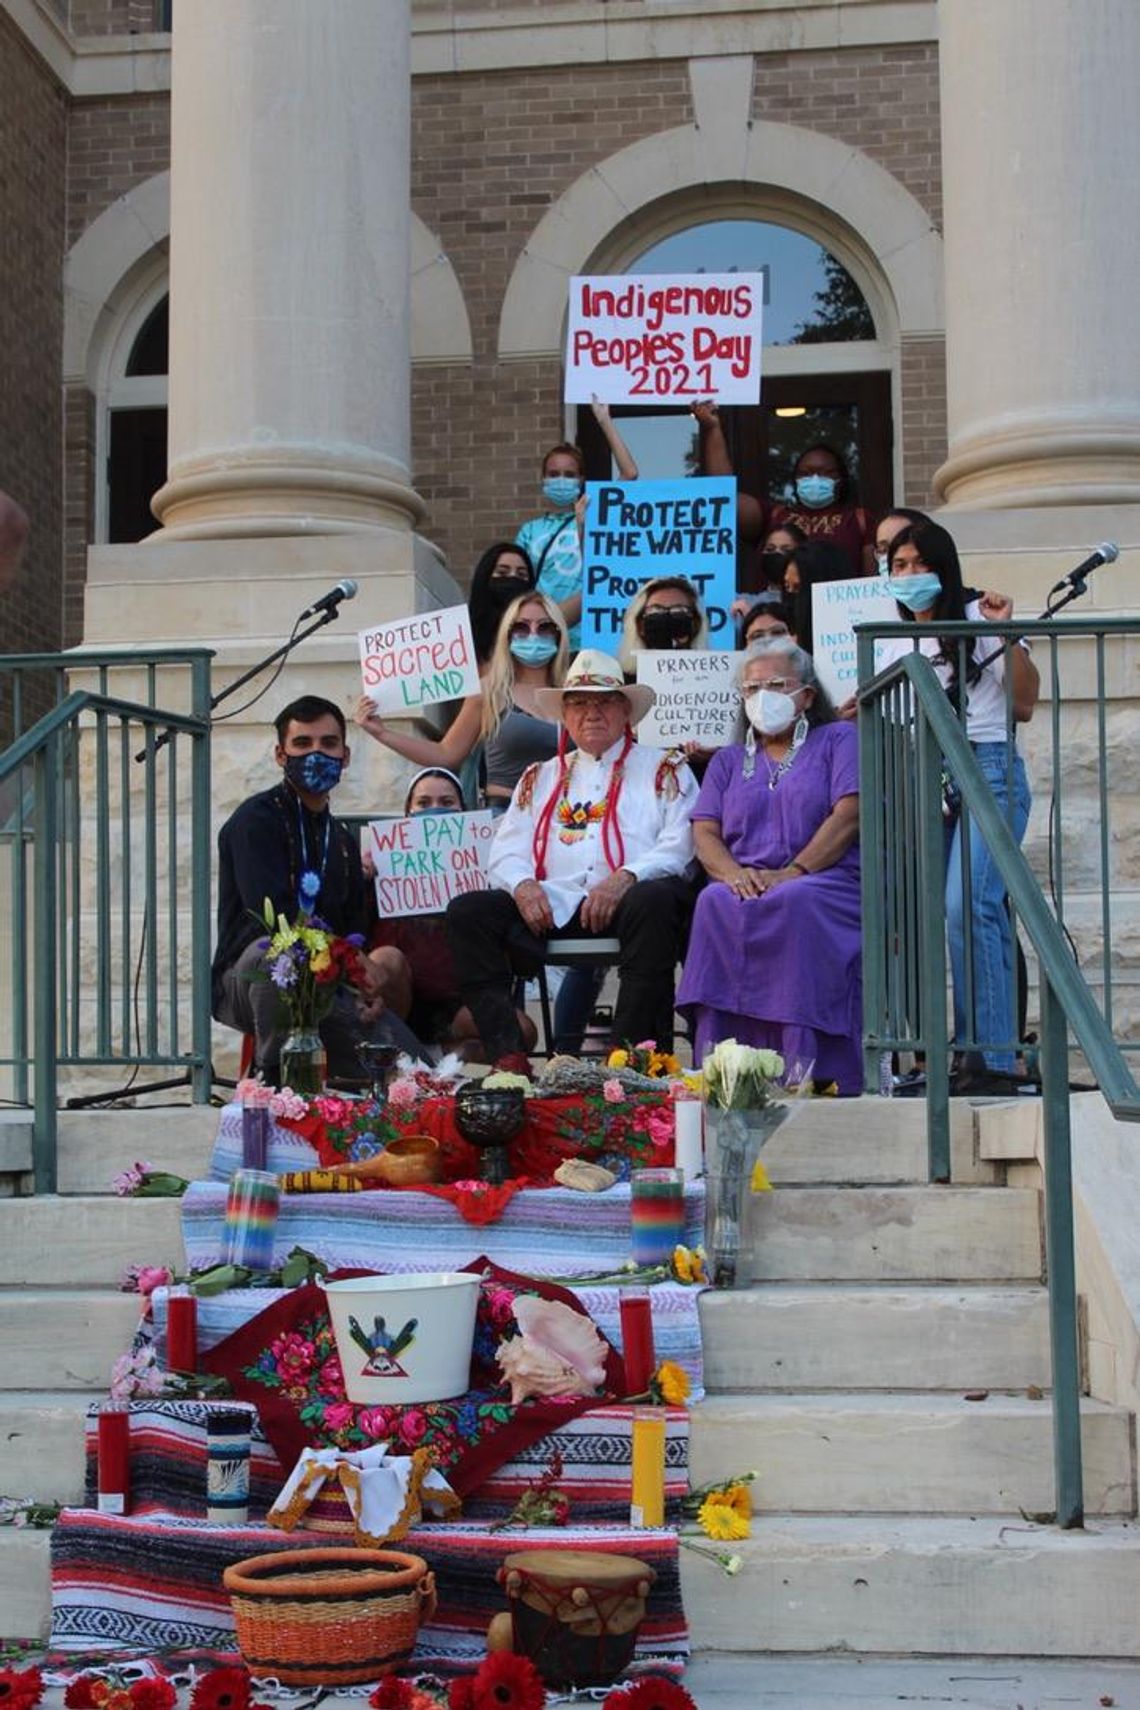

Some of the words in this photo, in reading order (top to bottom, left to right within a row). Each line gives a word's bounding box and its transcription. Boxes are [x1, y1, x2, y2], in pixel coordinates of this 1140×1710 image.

[582, 284, 752, 330] Indigenous
[693, 327, 751, 378] Day
[628, 364, 719, 395] 2021
[598, 487, 730, 528] PROTECT
[589, 531, 642, 557] THE
[646, 528, 734, 555] WATER
[365, 616, 442, 654] PROTECT
[587, 607, 625, 634] TH
[364, 624, 469, 685] sacred
[657, 655, 730, 673] PRAYERS
[401, 670, 464, 706] LAND
[658, 692, 740, 706] DIGENOUS
[654, 707, 737, 722] CULTURES
[659, 722, 725, 736] CENTER
[372, 820, 413, 851] WE
[423, 816, 465, 847] PAY
[469, 821, 492, 839] to
[390, 850, 446, 876] PARK
[452, 845, 479, 870] ON
[380, 873, 442, 914] STOLEN
